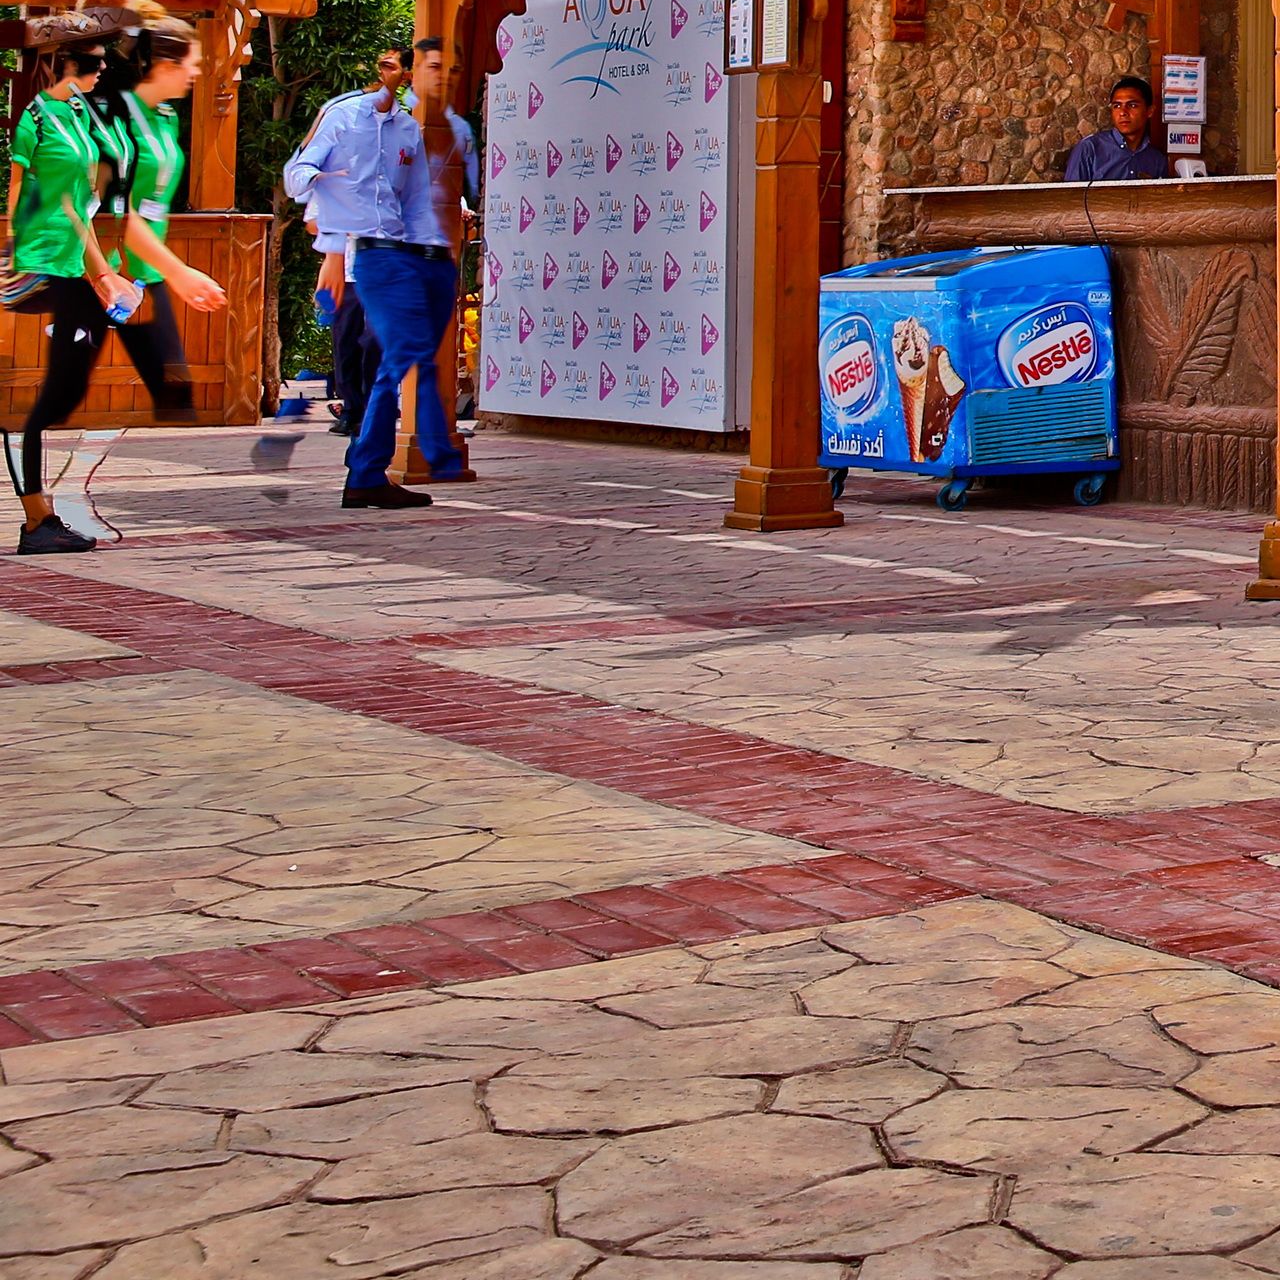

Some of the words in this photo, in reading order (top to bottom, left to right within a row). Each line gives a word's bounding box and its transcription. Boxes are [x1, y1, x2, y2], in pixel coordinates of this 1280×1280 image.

[609, 65, 629, 78] HOTEL
[631, 66, 636, 76] &
[637, 63, 650, 75] SPA
[1169, 132, 1199, 145] SANITIZER
[1042, 306, 1067, 330] آيس
[1018, 318, 1041, 345] كريم
[1017, 329, 1092, 385] Nestlé
[829, 351, 873, 398] Nestlé
